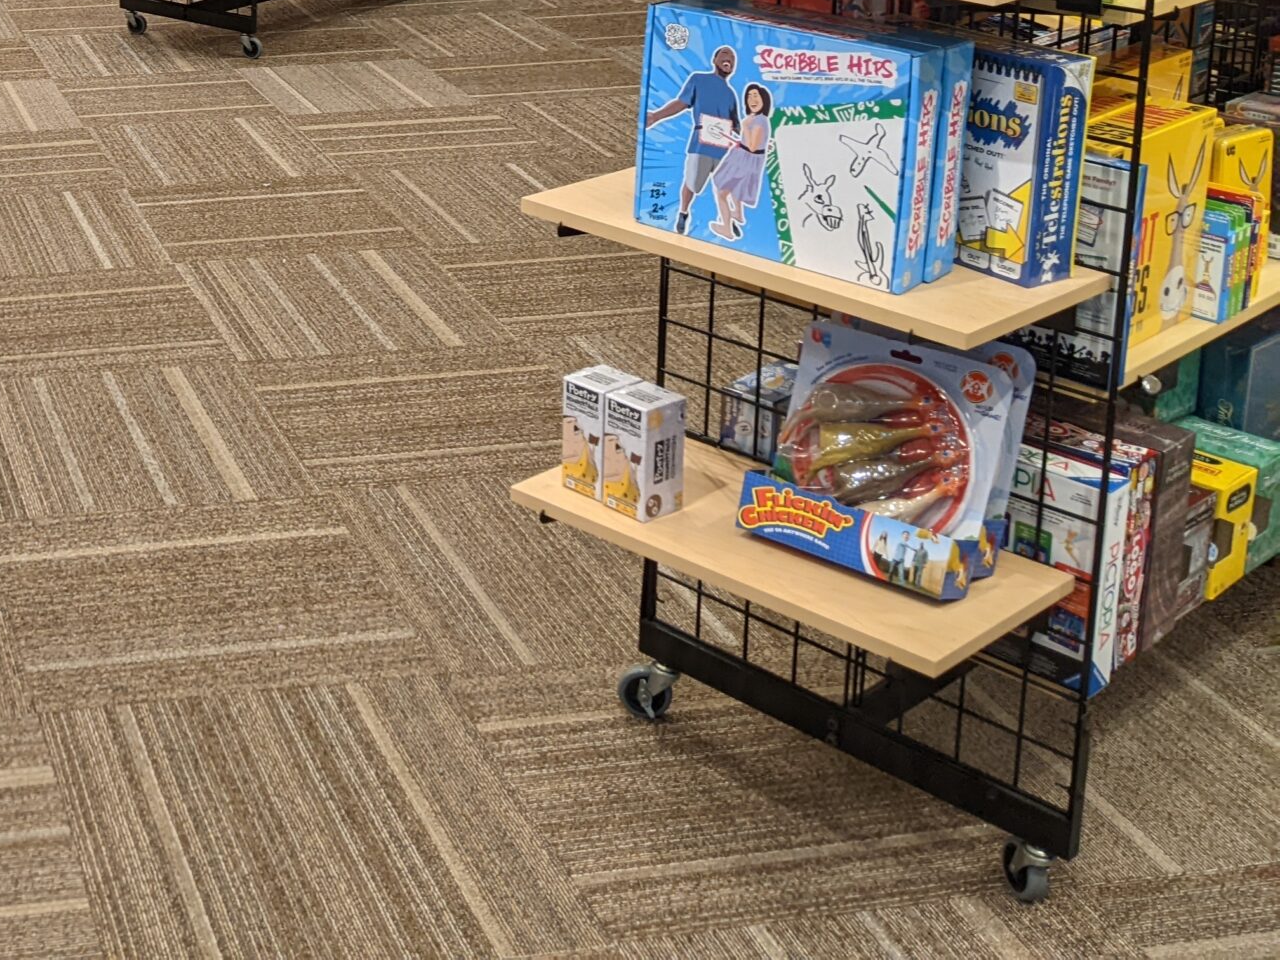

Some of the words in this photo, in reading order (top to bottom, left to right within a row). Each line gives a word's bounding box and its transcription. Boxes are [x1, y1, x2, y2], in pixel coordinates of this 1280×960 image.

[848, 54, 894, 79] HIPS
[1041, 94, 1073, 249] Telestrations
[652, 202, 665, 213] 2+
[568, 384, 599, 403] Poetry
[609, 399, 642, 420] Poetry
[654, 442, 664, 483] Poetry
[740, 505, 827, 537] CHICKEN
[1098, 541, 1121, 651] PICTOPIA
